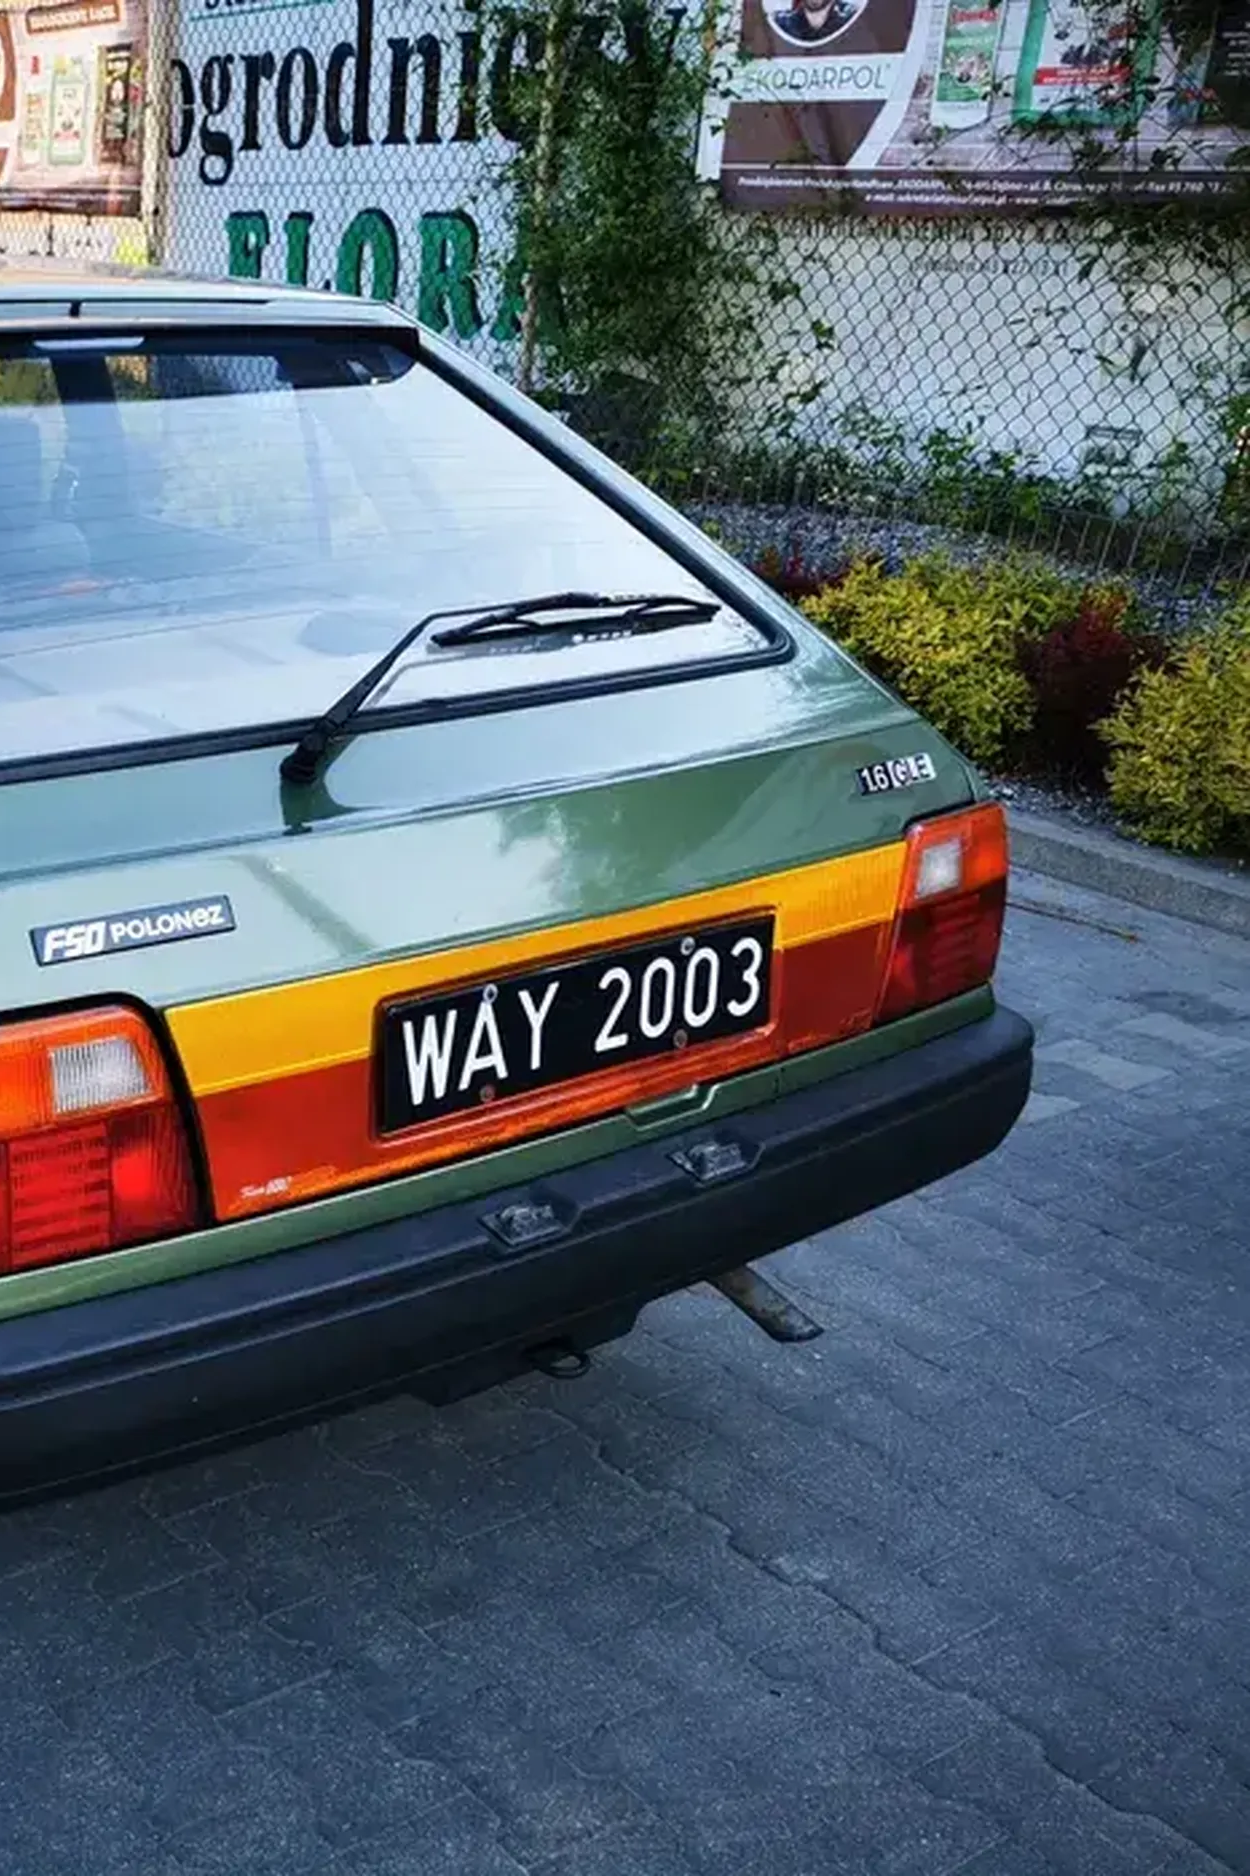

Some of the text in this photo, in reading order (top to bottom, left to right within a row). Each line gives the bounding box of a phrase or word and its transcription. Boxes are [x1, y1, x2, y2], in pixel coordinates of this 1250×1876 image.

[43, 921, 106, 962] FSO
[402, 937, 763, 1106] WAY 2003
